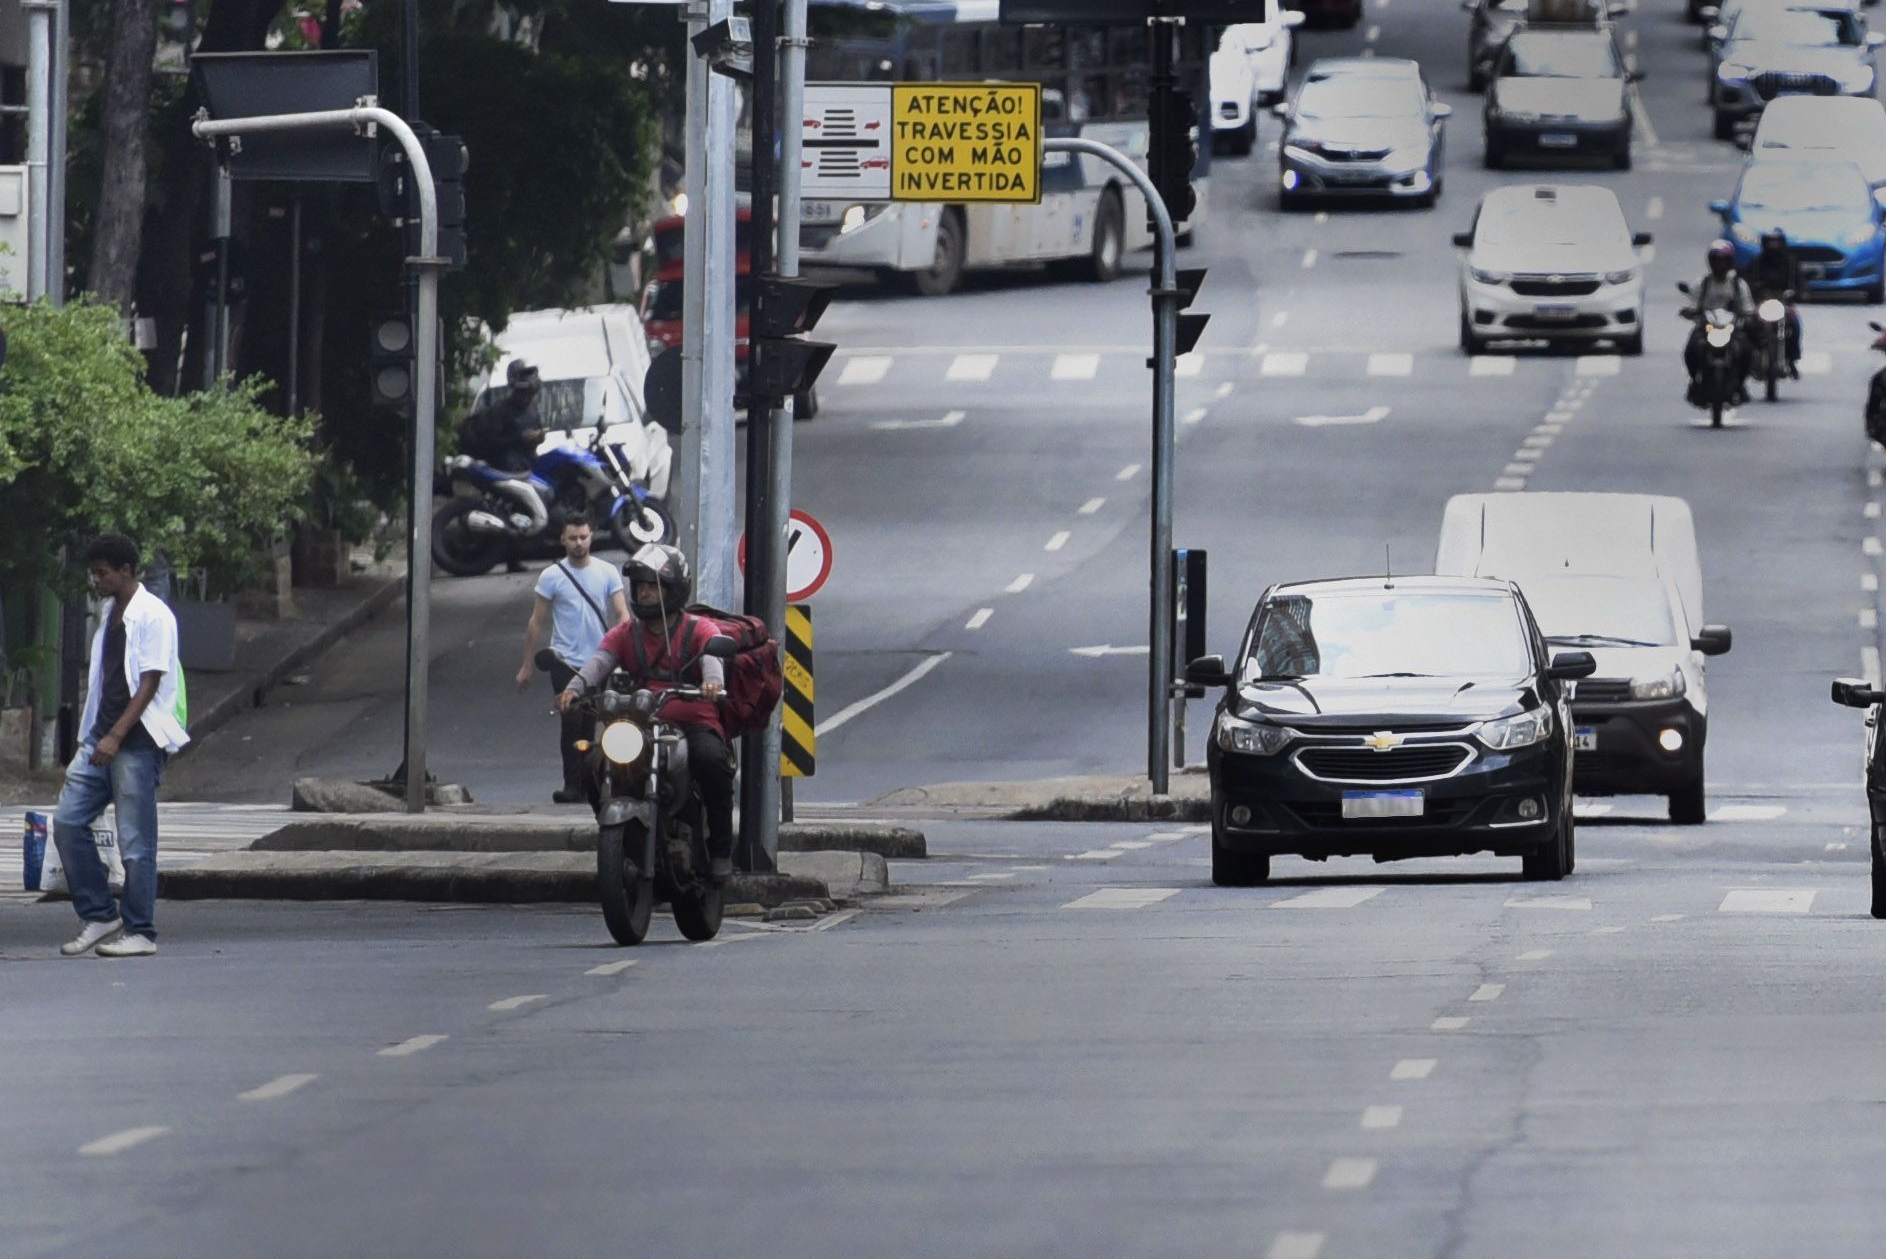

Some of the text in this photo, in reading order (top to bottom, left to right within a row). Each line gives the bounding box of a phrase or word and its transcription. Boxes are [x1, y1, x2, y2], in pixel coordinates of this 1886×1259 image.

[907, 91, 1022, 118] ATENÇÃO!
[897, 121, 1031, 140] TRAVESSIA
[905, 142, 1022, 165] COM MÃO
[900, 172, 1026, 191] INVERTIDA
